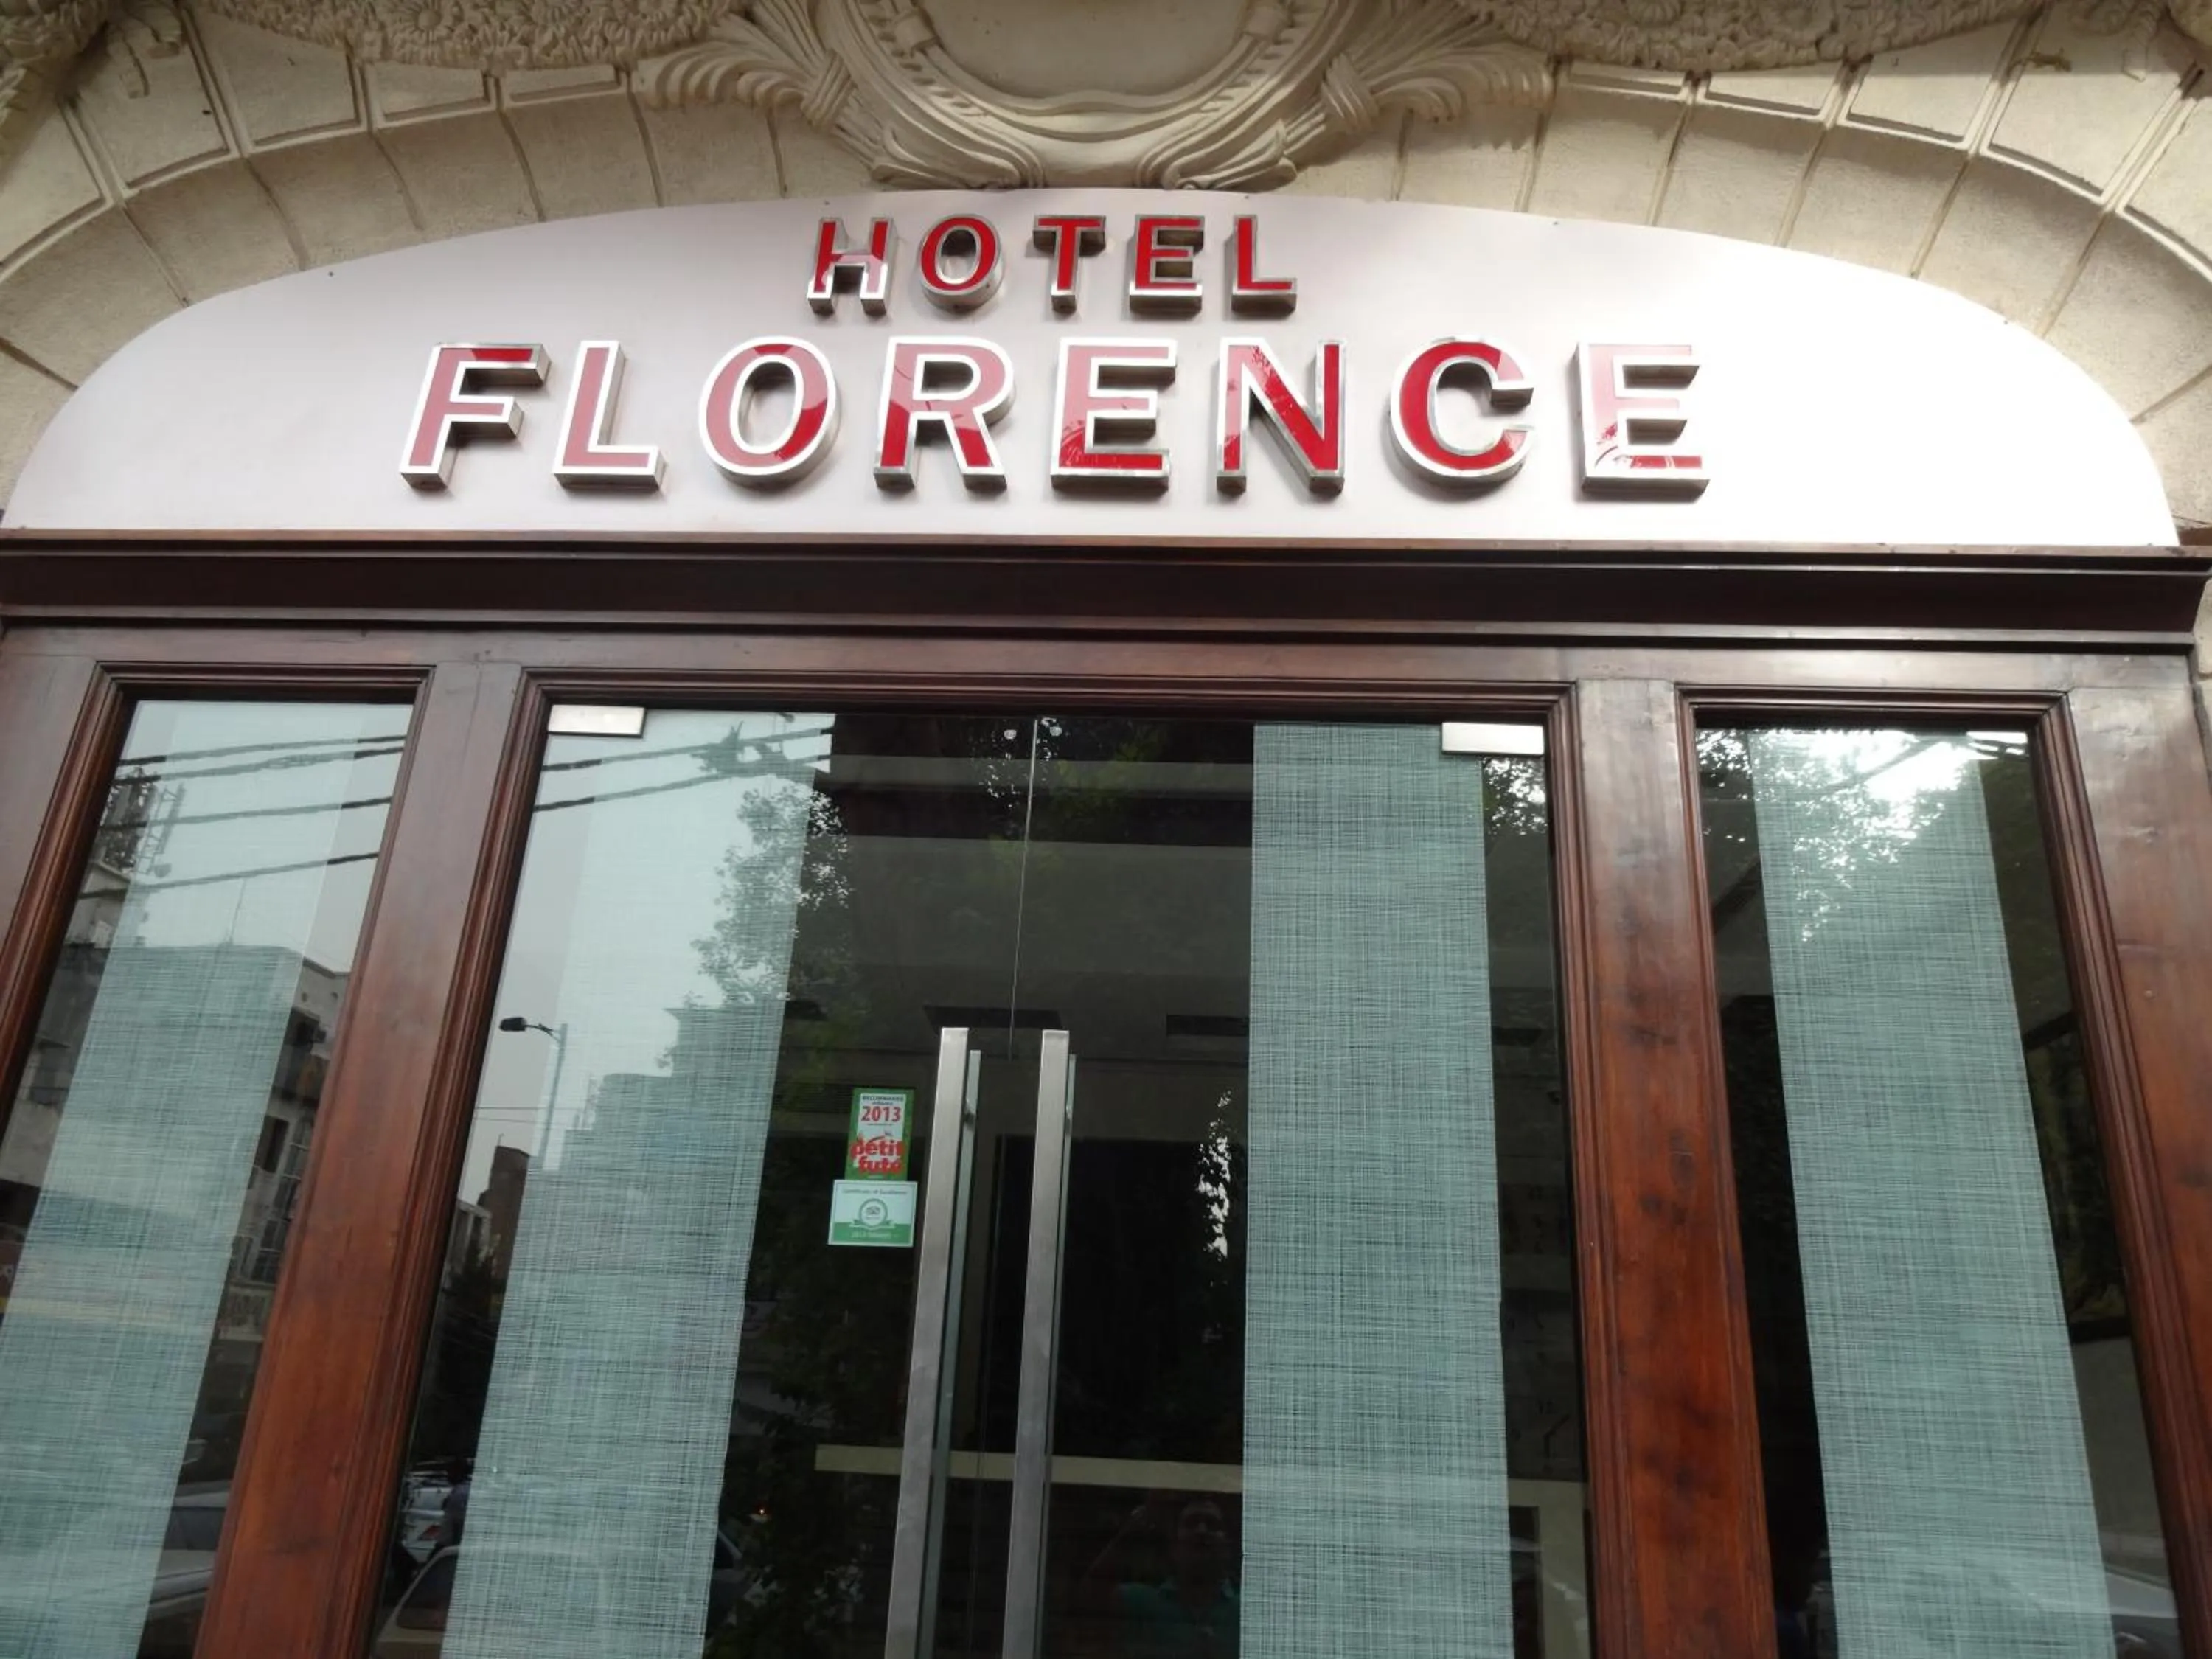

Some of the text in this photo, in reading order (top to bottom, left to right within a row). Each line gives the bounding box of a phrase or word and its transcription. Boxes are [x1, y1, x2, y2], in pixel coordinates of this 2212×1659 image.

[806, 215, 1298, 313] HOTEL
[398, 335, 1711, 500] FLORENCE
[860, 1106, 901, 1122] 2013
[849, 1137, 905, 1160] petit
